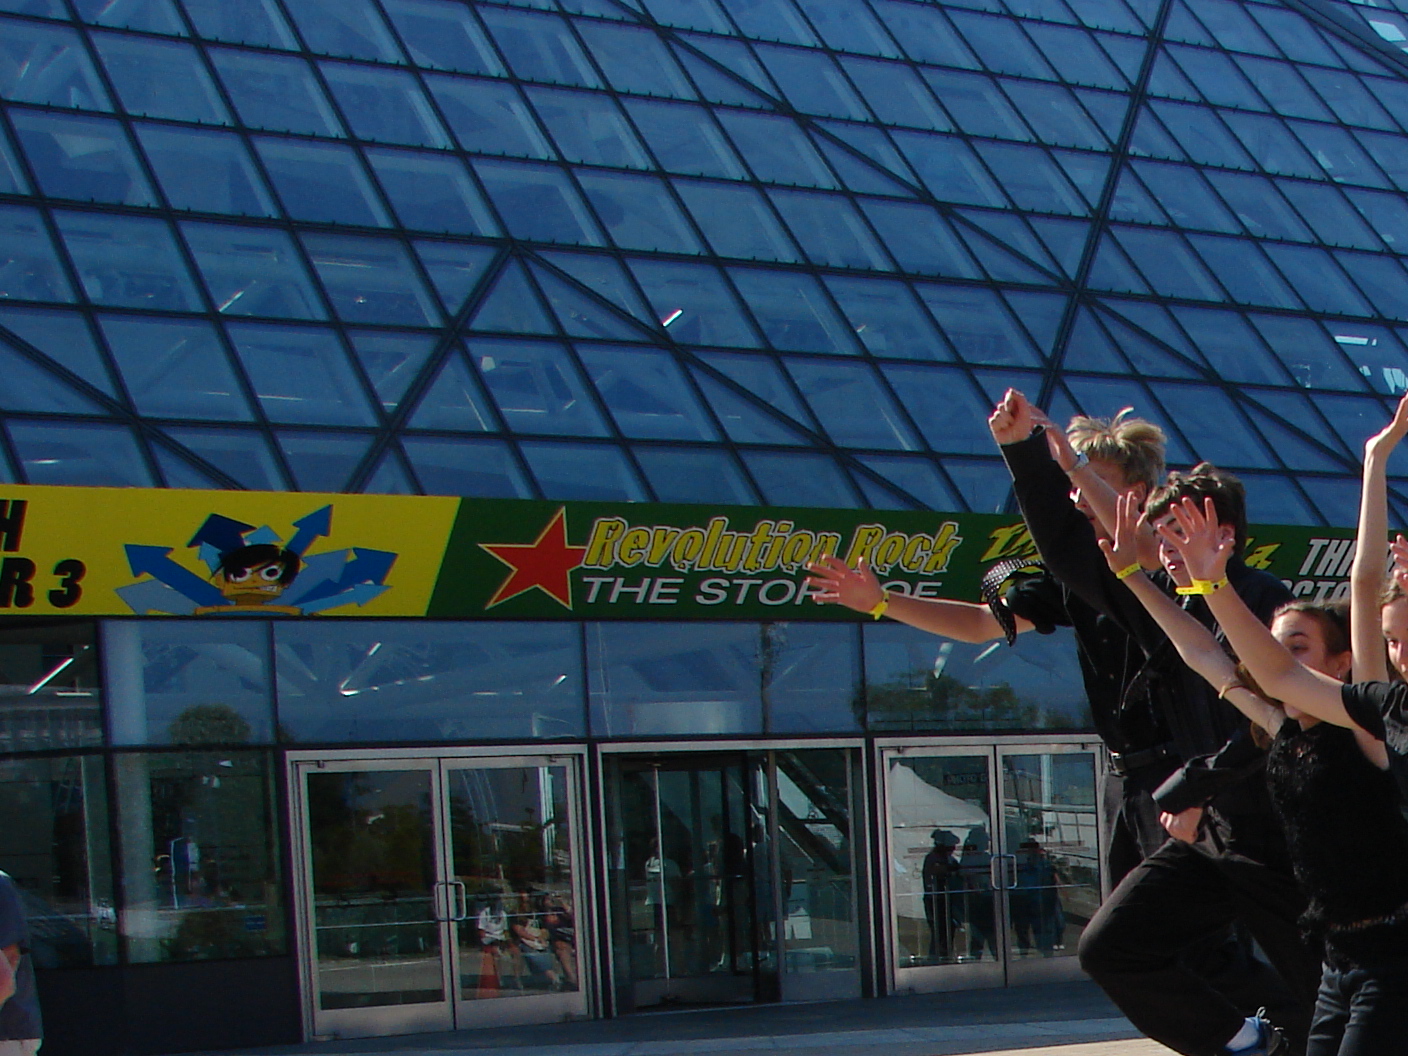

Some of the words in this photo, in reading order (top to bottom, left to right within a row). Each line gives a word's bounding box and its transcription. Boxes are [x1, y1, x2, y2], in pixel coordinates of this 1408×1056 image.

[582, 516, 841, 575] Revolution
[846, 522, 963, 576] Rock
[48, 559, 86, 609] 3
[583, 577, 684, 604] THE
